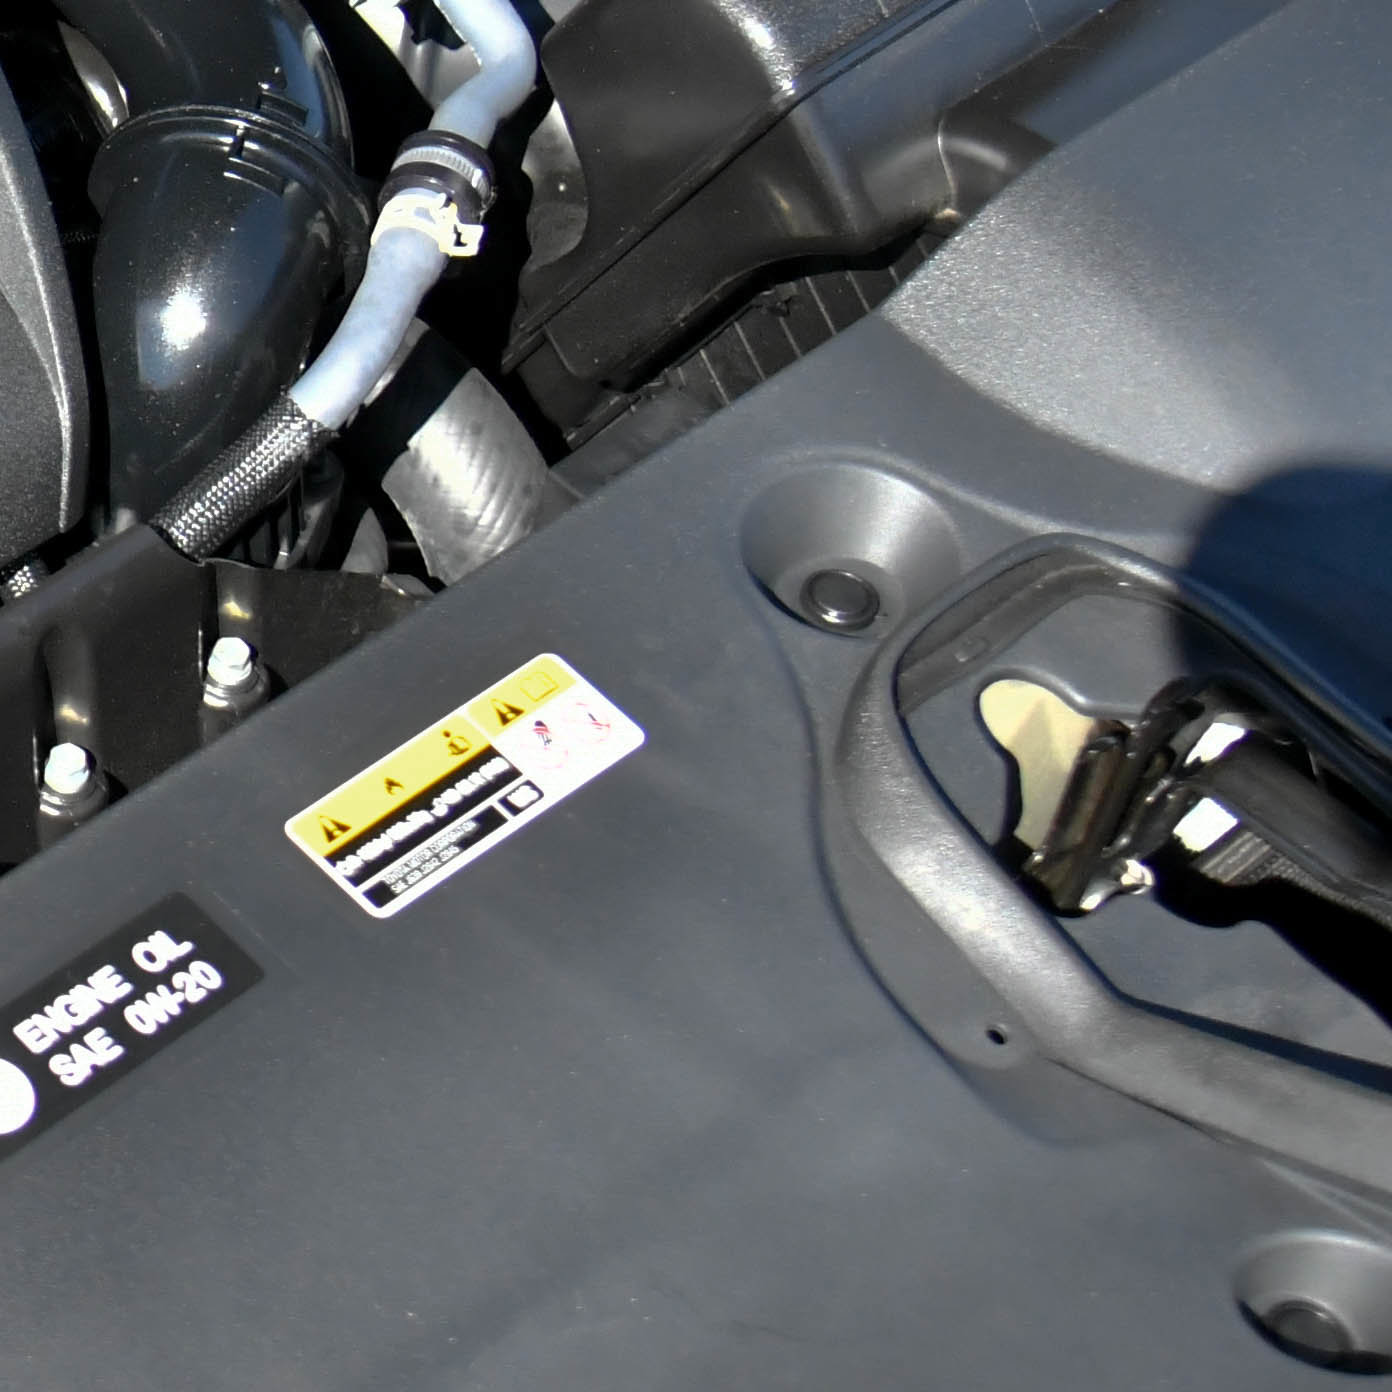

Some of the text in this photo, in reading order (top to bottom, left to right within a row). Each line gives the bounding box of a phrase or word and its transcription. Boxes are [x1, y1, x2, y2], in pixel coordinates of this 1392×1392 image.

[12, 930, 195, 1054] ENGINE OIL
[48, 960, 223, 1087] SAE 0W-20
